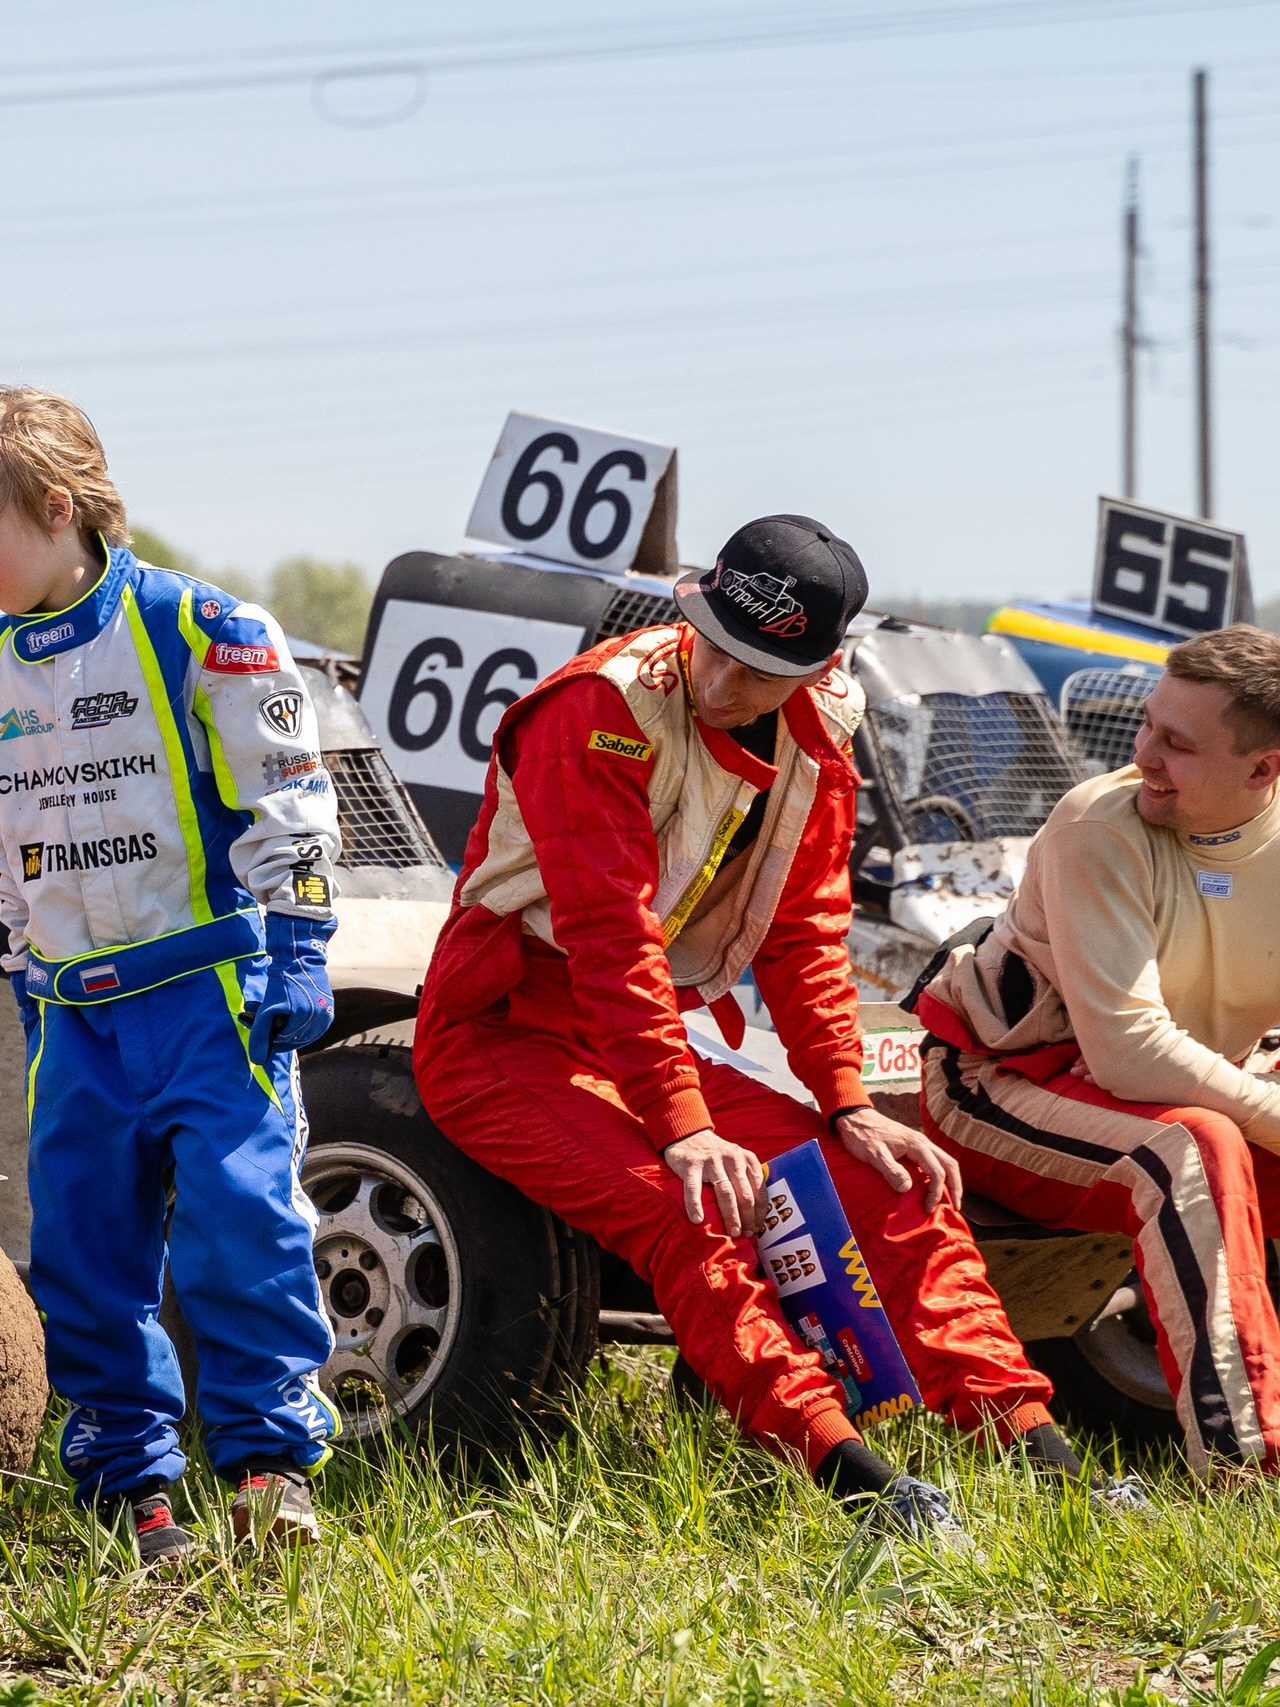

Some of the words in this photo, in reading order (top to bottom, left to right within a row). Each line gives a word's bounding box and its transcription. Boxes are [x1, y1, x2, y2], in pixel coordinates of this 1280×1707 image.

[502, 432, 646, 560] 66
[1100, 509, 1234, 634] 65
[726, 585, 790, 623] СПРИНТ
[27, 623, 74, 653] freem
[216, 643, 267, 665] freem
[387, 637, 538, 763] 66
[19, 710, 40, 725] HS
[25, 723, 54, 735] GROUP
[595, 734, 648, 758] Sabelt
[83, 789, 117, 805] HOUSE
[45, 832, 158, 872] TRANSGAS
[879, 1038, 919, 1073] Cas
